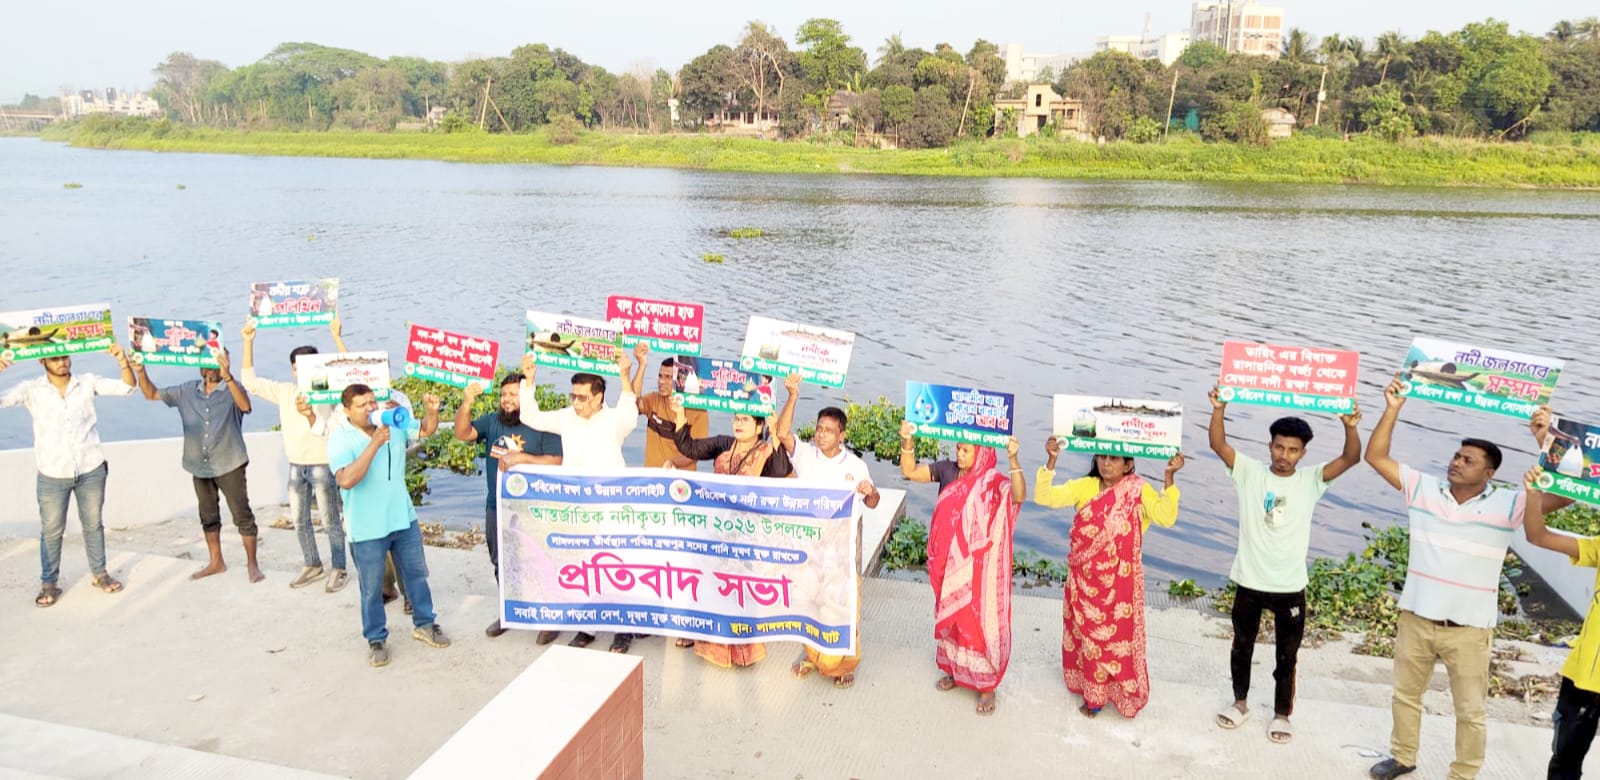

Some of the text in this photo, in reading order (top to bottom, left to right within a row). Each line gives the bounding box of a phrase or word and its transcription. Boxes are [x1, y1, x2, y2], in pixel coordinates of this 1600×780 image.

[275, 297, 321, 313] পলিথিন
[616, 300, 694, 320] বালু খেকোদের হাত
[33, 312, 53, 325] নদী
[633, 316, 649, 333] নদী
[652, 318, 680, 336] বাঁচাতে
[683, 326, 699, 340] হবে
[66, 324, 106, 340] সম্পদ
[557, 320, 616, 341] নদী জনগণের
[582, 342, 615, 360] সম্পদ
[1279, 351, 1297, 361] এর
[1301, 349, 1336, 362] বিষাক্ত
[1233, 359, 1285, 373] রাসায়নিক
[1317, 367, 1346, 379] থেকে
[1455, 349, 1548, 379] নদী জনগণের
[711, 368, 746, 383] পলিথিন
[1225, 373, 1257, 385] মেঘনা
[1261, 374, 1281, 388] নদী
[1286, 379, 1309, 390] রক্ষা
[1312, 381, 1343, 393] করুন
[1237, 388, 1264, 401] পরিবেশ
[1414, 384, 1442, 399] পরিবেশ
[1485, 374, 1543, 400] সম্পদ
[976, 415, 996, 428] আর
[998, 418, 1009, 430] না
[1121, 418, 1155, 430] নদীকে
[1070, 437, 1096, 449] পরিবেশ
[1098, 442, 1112, 452] রক্ষা
[1123, 442, 1143, 455] উন্নয়ন
[531, 479, 664, 497] পরিবেশ রক্ষা ও উন্নয়ন সোসাইটি
[1556, 478, 1591, 497] পরিবেশ
[695, 488, 842, 512] পরিবেশ ও নদী রক্ষা উন্নয়ন পরিষদ
[529, 504, 822, 540] আন্তর্জাতিক নদীকৃত্য দিবস ২০২৬ উপলক্ষ্যে
[592, 535, 626, 549] তীর্থস্থান
[710, 542, 728, 556] পানি
[732, 545, 750, 560] দূষণ
[753, 549, 768, 561] মুক্ত
[772, 550, 800, 562] রাখতে
[558, 552, 794, 609] প্রতিবাদ সভা
[514, 606, 538, 620] সবাই
[540, 606, 564, 621] মিলে
[567, 609, 596, 622] গড়বো
[600, 610, 624, 623] দেশ,
[626, 610, 648, 624] দূষণ
[652, 613, 668, 626] মুক্ত
[670, 614, 714, 630] বাংলাদেশ
[805, 622, 820, 640] রাজ
[822, 630, 840, 644] ঘাট
